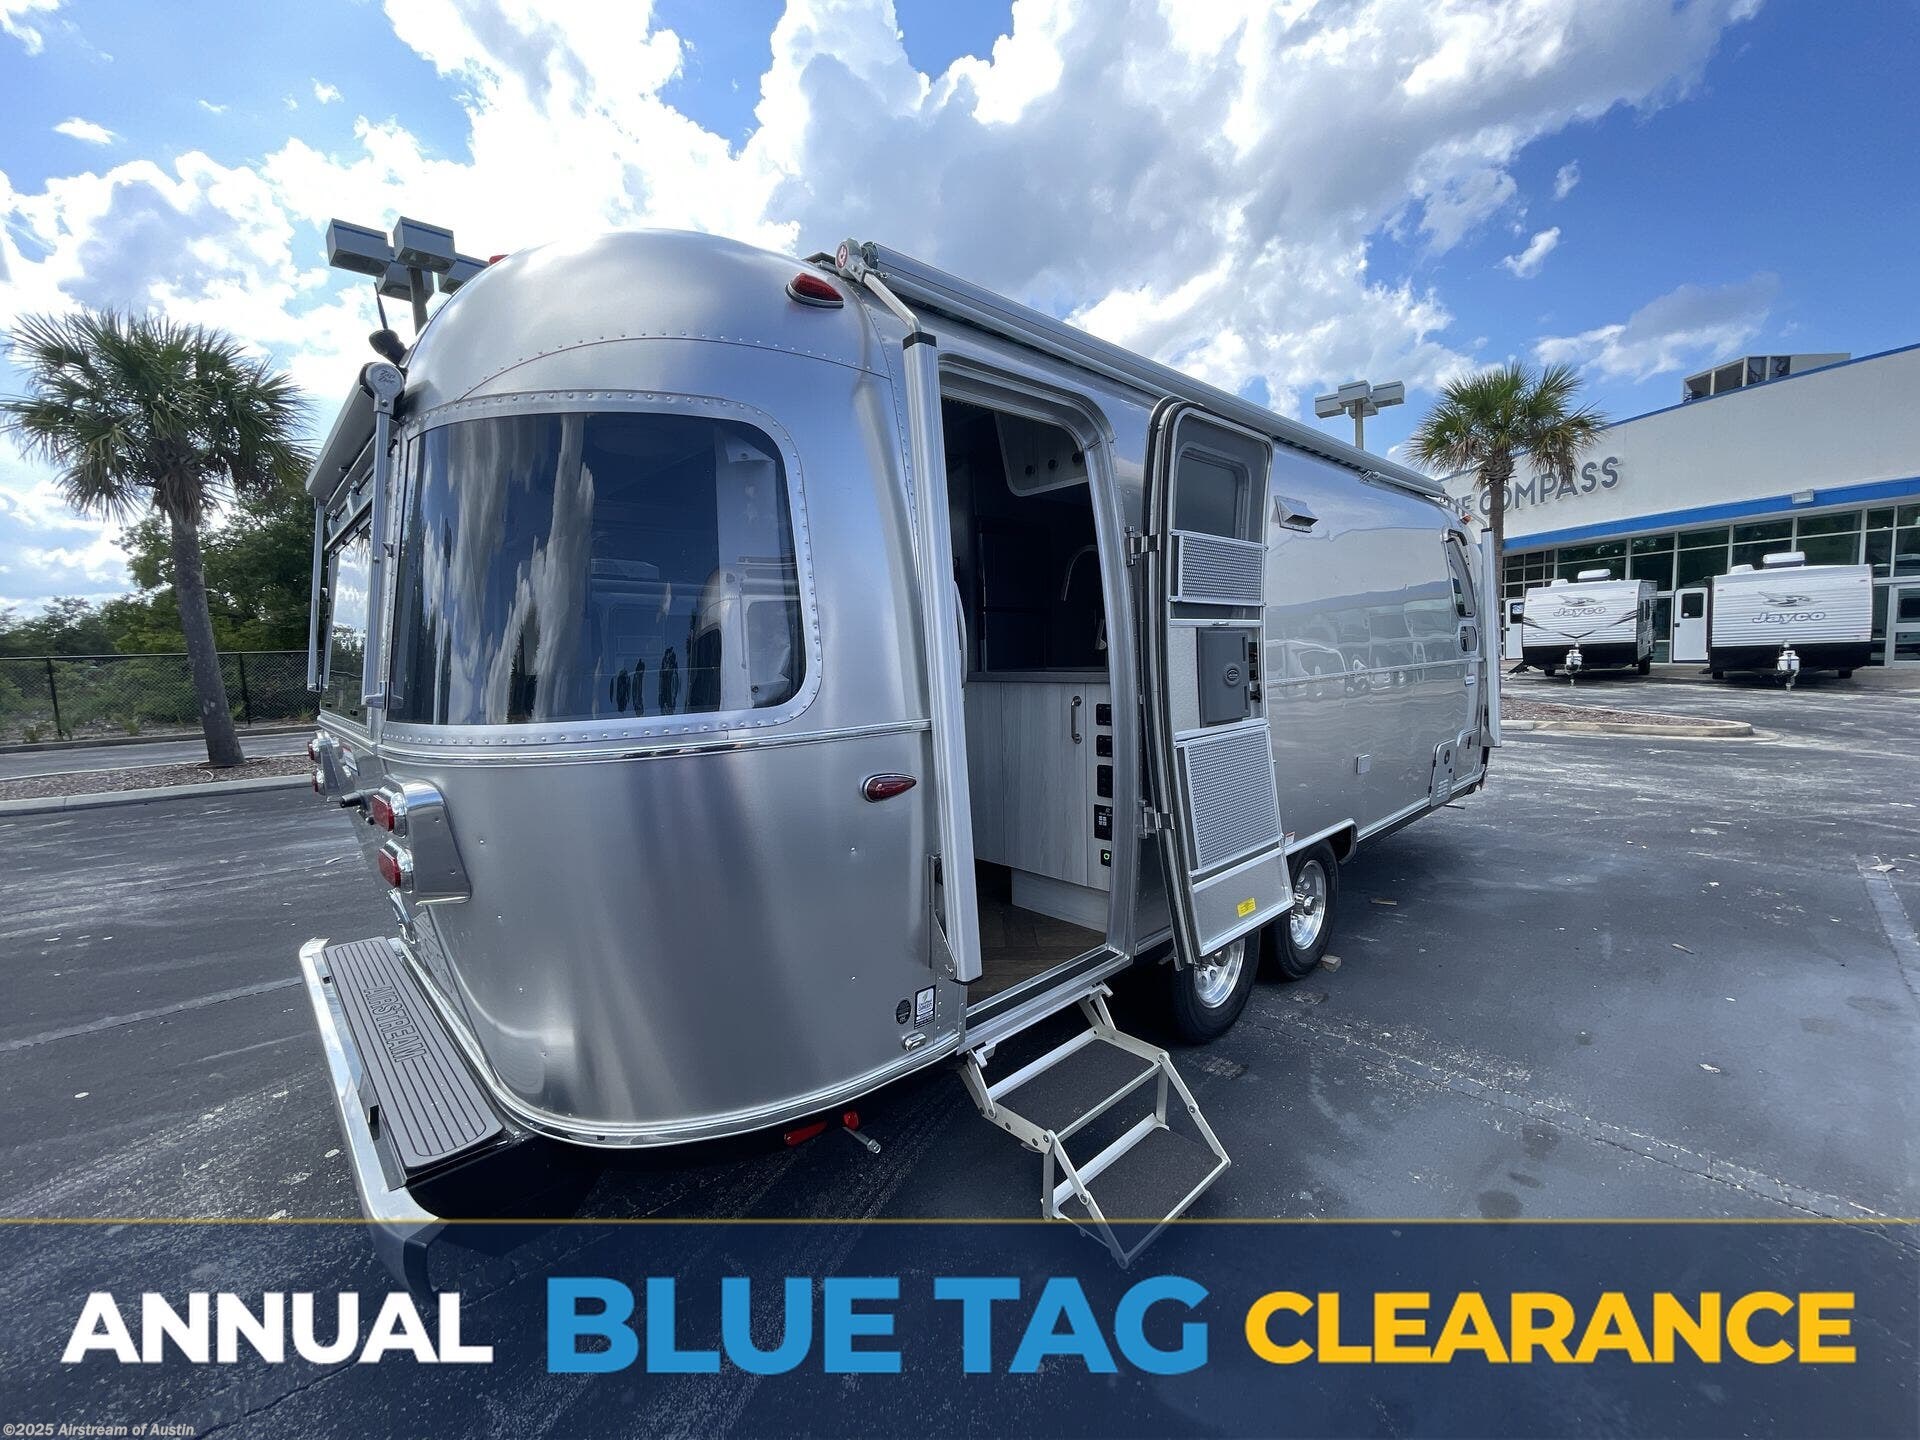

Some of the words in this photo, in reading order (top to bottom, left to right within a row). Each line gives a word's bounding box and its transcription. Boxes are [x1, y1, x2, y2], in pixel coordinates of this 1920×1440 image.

[1553, 607, 1607, 617] Jayco
[1752, 611, 1826, 624] Jayco
[363, 986, 427, 1063] AIRSTREAM
